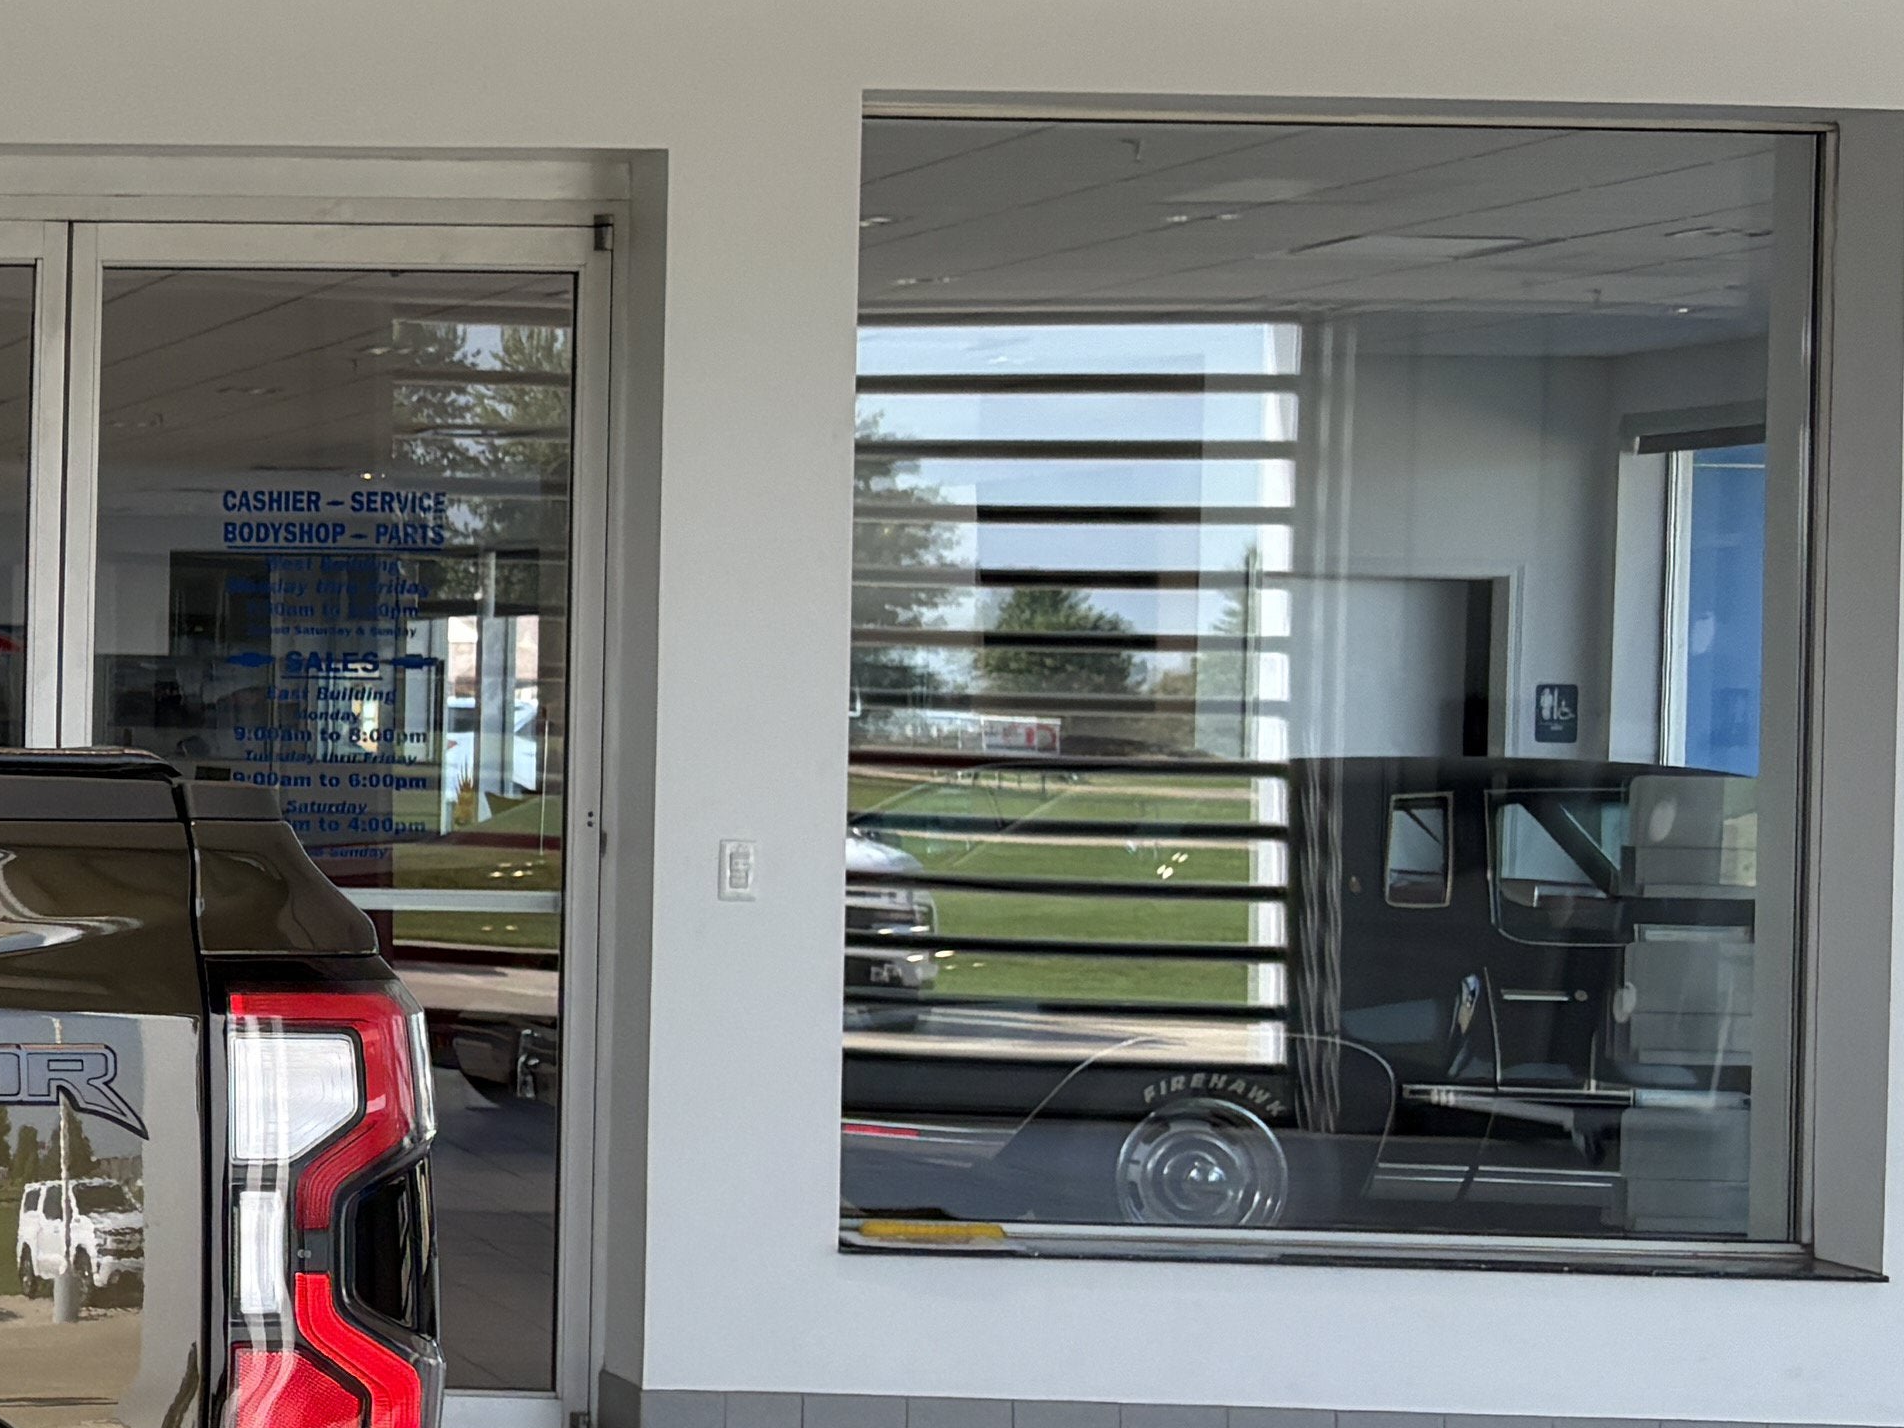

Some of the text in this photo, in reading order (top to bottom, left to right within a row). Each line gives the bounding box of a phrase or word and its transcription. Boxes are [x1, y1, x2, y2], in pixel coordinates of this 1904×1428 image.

[223, 490, 447, 514] CASHIER SERVICE
[223, 522, 444, 545] BODYSHOP PARTS
[285, 651, 380, 673] SALES
[317, 687, 397, 705] Building
[321, 727, 340, 743] to
[320, 772, 340, 788] to
[349, 773, 427, 790] 6:00pm
[286, 800, 367, 816] Saturday
[319, 817, 341, 832] to
[349, 817, 426, 835] 4:00pm
[1143, 1072, 1286, 1117] FIREHAWK
